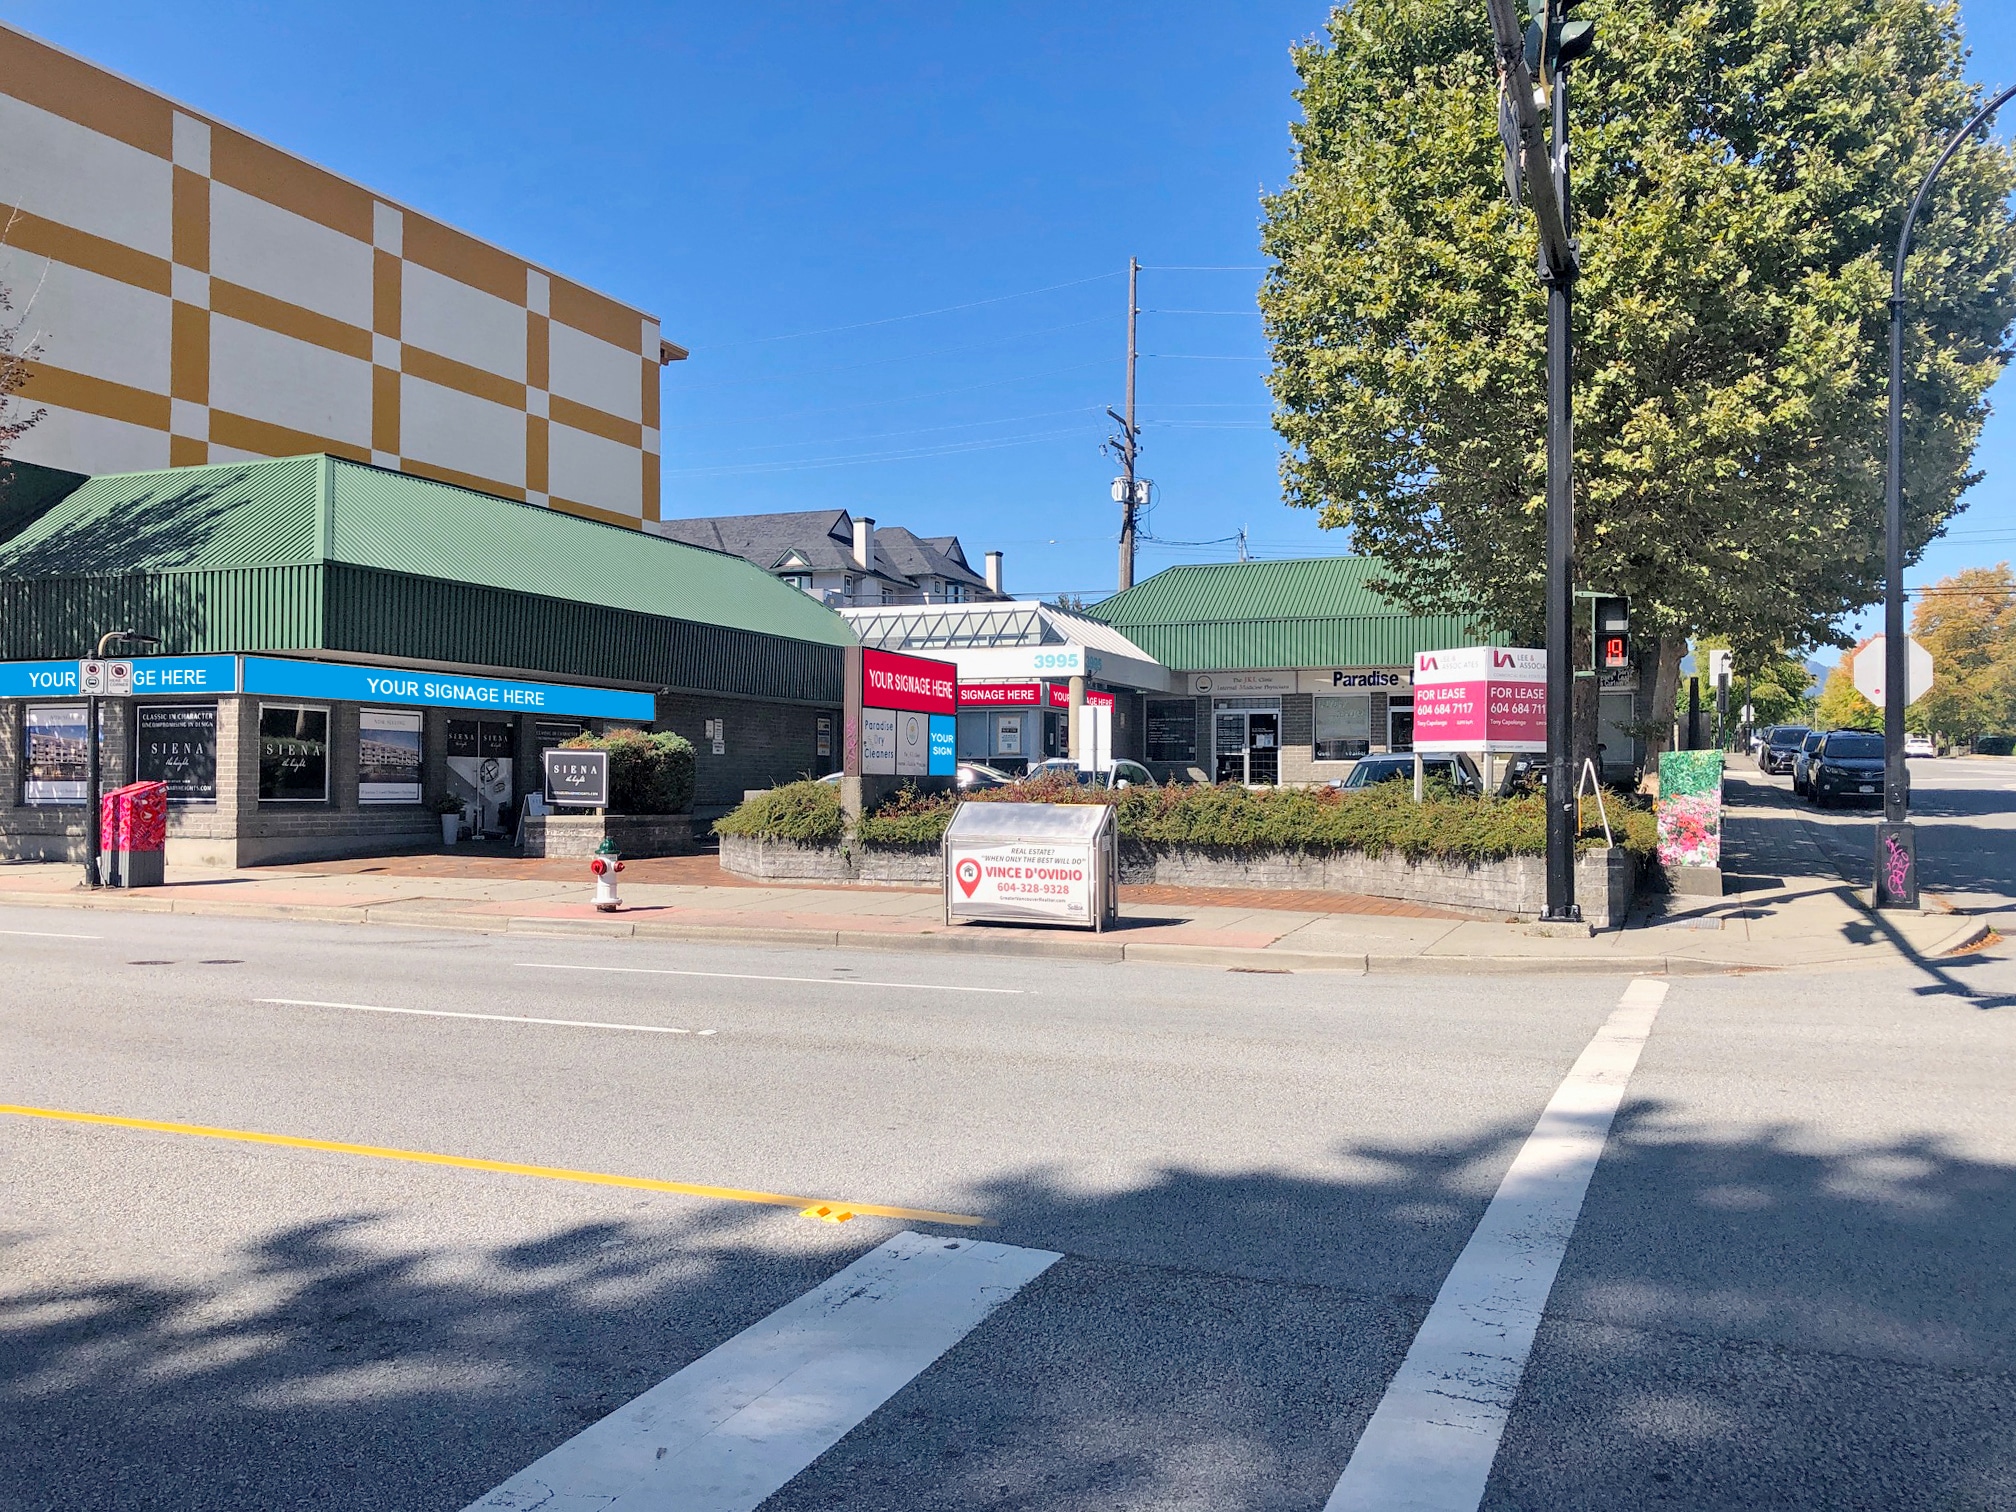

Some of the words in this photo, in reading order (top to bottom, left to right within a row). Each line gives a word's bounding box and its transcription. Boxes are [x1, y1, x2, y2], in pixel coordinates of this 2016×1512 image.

[1517, 654, 1529, 662] LEE
[1607, 639, 1623, 666] 19
[1034, 653, 1079, 669] 3995
[1519, 662, 1546, 670] ASSOCIA
[28, 671, 77, 688] YOUR
[161, 669, 207, 685] HERE
[868, 669, 894, 690] YOUR
[895, 673, 931, 696] SIGNAGE
[932, 679, 953, 700] HERE
[1333, 670, 1399, 687] Paradise
[367, 678, 419, 697] YOUR
[424, 682, 499, 703] SIGNAGE
[503, 689, 545, 706] HERE
[961, 690, 1005, 700] SIGNAGE
[1007, 690, 1035, 700] HERE
[1417, 690, 1435, 701] FOR
[1437, 687, 1466, 700] LEASE
[1490, 687, 1512, 698] FOR
[1515, 688, 1544, 700] LEASE
[1417, 704, 1432, 716] 604
[1434, 703, 1451, 715] 684
[1452, 702, 1474, 714] 7117
[1490, 703, 1509, 714] 604
[1511, 703, 1530, 714] 684
[1532, 704, 1546, 715] 711
[177, 712, 213, 720] CHARACTER
[864, 719, 894, 731] Paradise
[931, 732, 954, 743] YOUR
[151, 742, 203, 755] SIENA
[266, 743, 321, 757] SIENA
[864, 748, 894, 759] Cleaners
[932, 746, 952, 756] SIGN
[553, 764, 598, 775] SIENA
[985, 866, 1022, 879] VINCE
[1025, 867, 1083, 881] D'OVIDIO
[997, 882, 1070, 895] 604-328-9328
